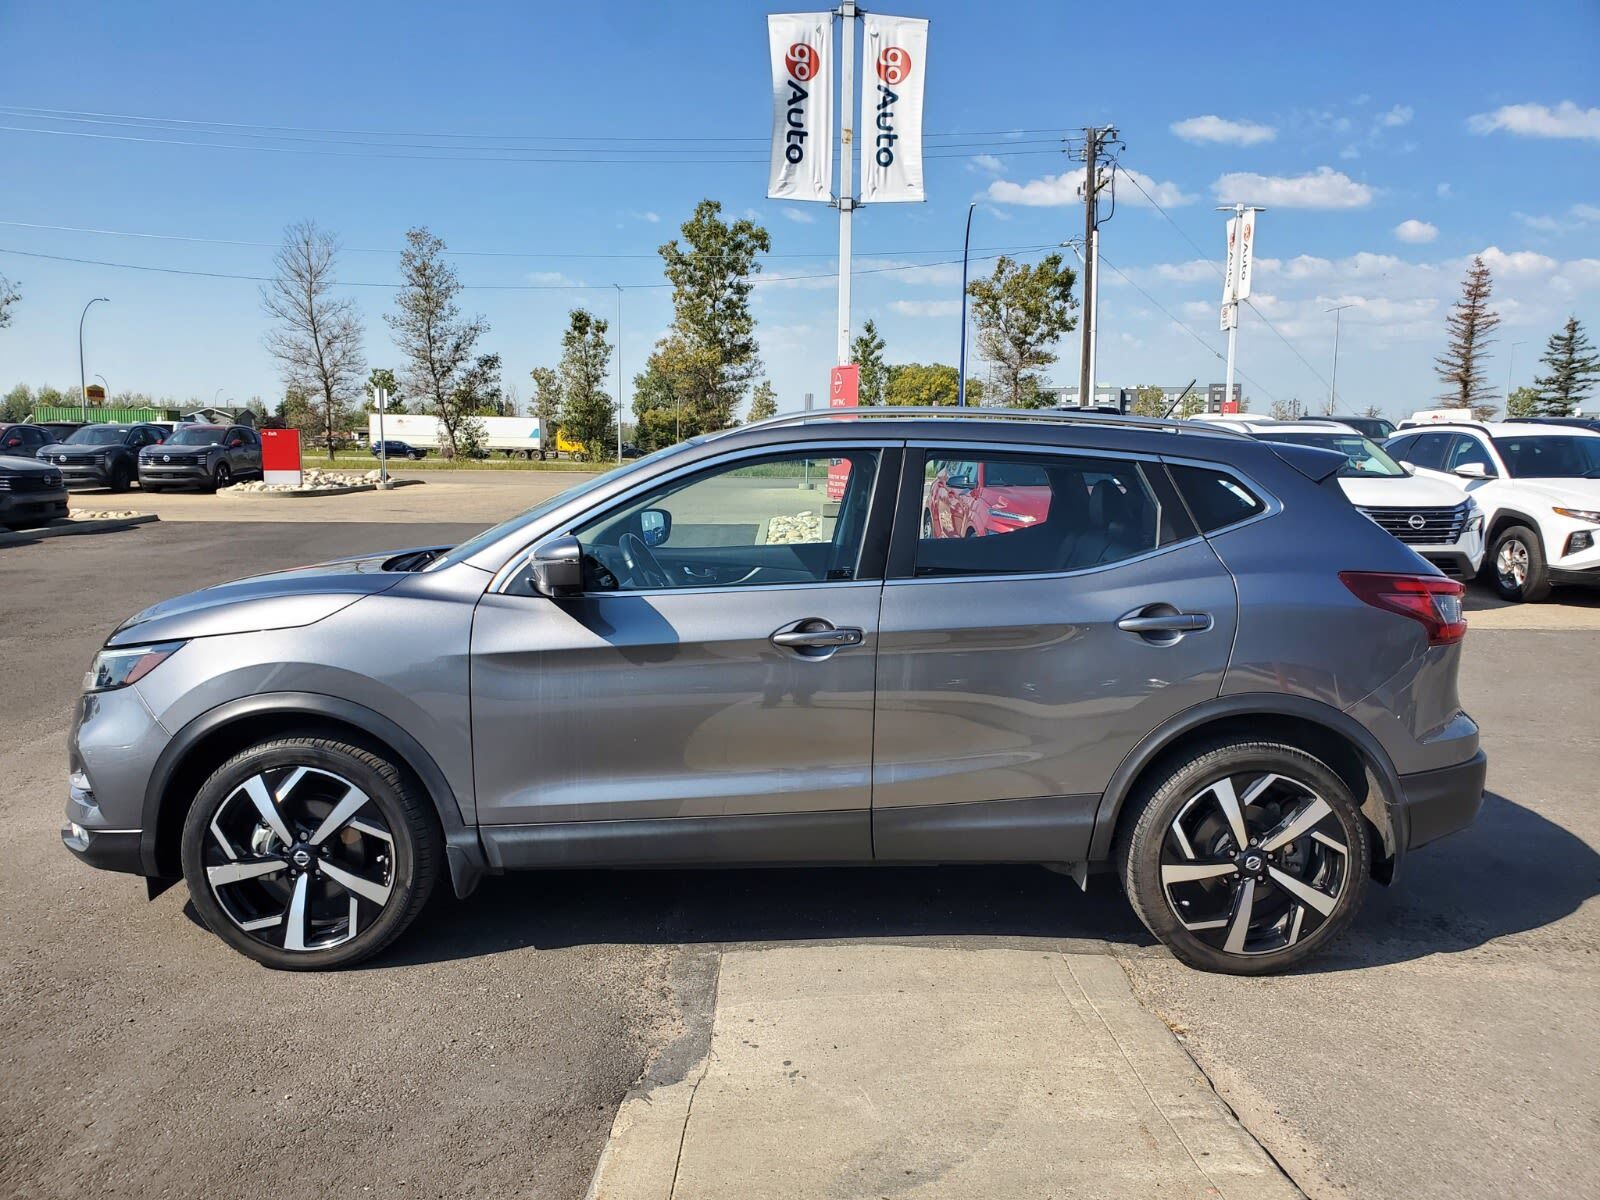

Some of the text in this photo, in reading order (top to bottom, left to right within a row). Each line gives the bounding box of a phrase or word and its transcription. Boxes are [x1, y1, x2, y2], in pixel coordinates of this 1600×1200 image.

[785, 43, 812, 164] go Auto
[876, 47, 903, 167] go Auto
[1241, 243, 1249, 280] Auto
